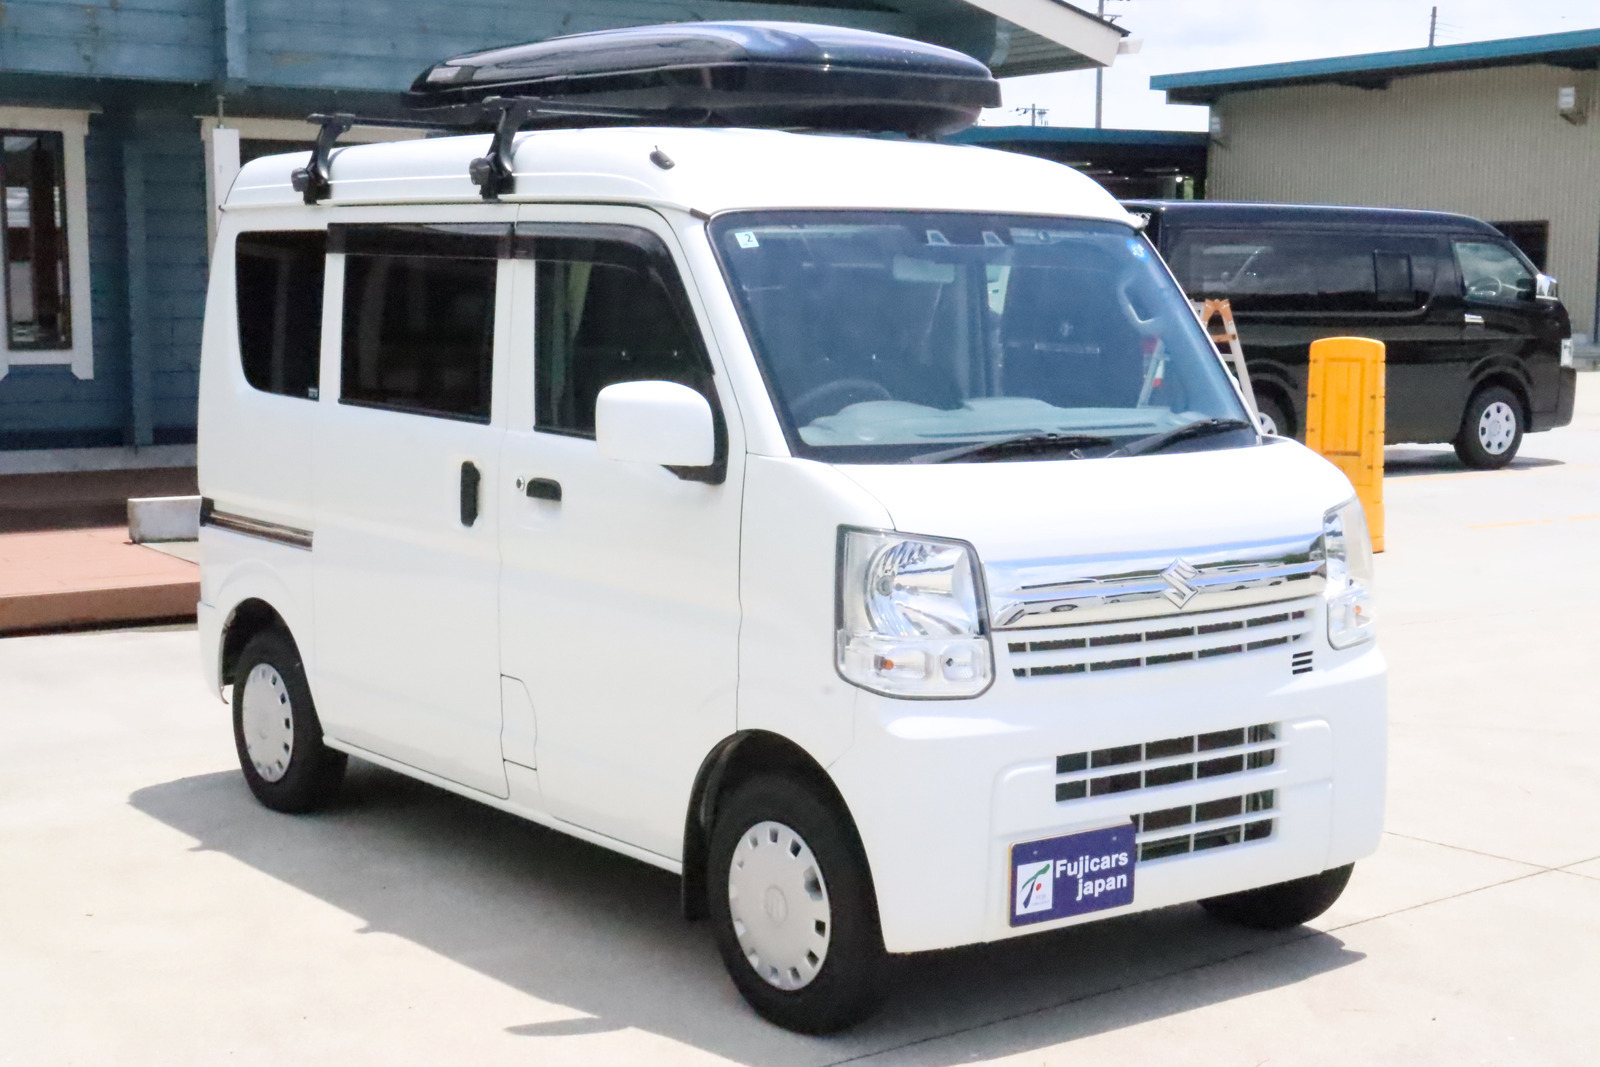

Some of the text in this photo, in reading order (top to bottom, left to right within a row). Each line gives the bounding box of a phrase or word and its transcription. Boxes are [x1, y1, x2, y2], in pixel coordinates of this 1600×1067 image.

[744, 233, 754, 243] 2
[1055, 852, 1128, 878] Fujicars
[1076, 874, 1127, 901] japan
